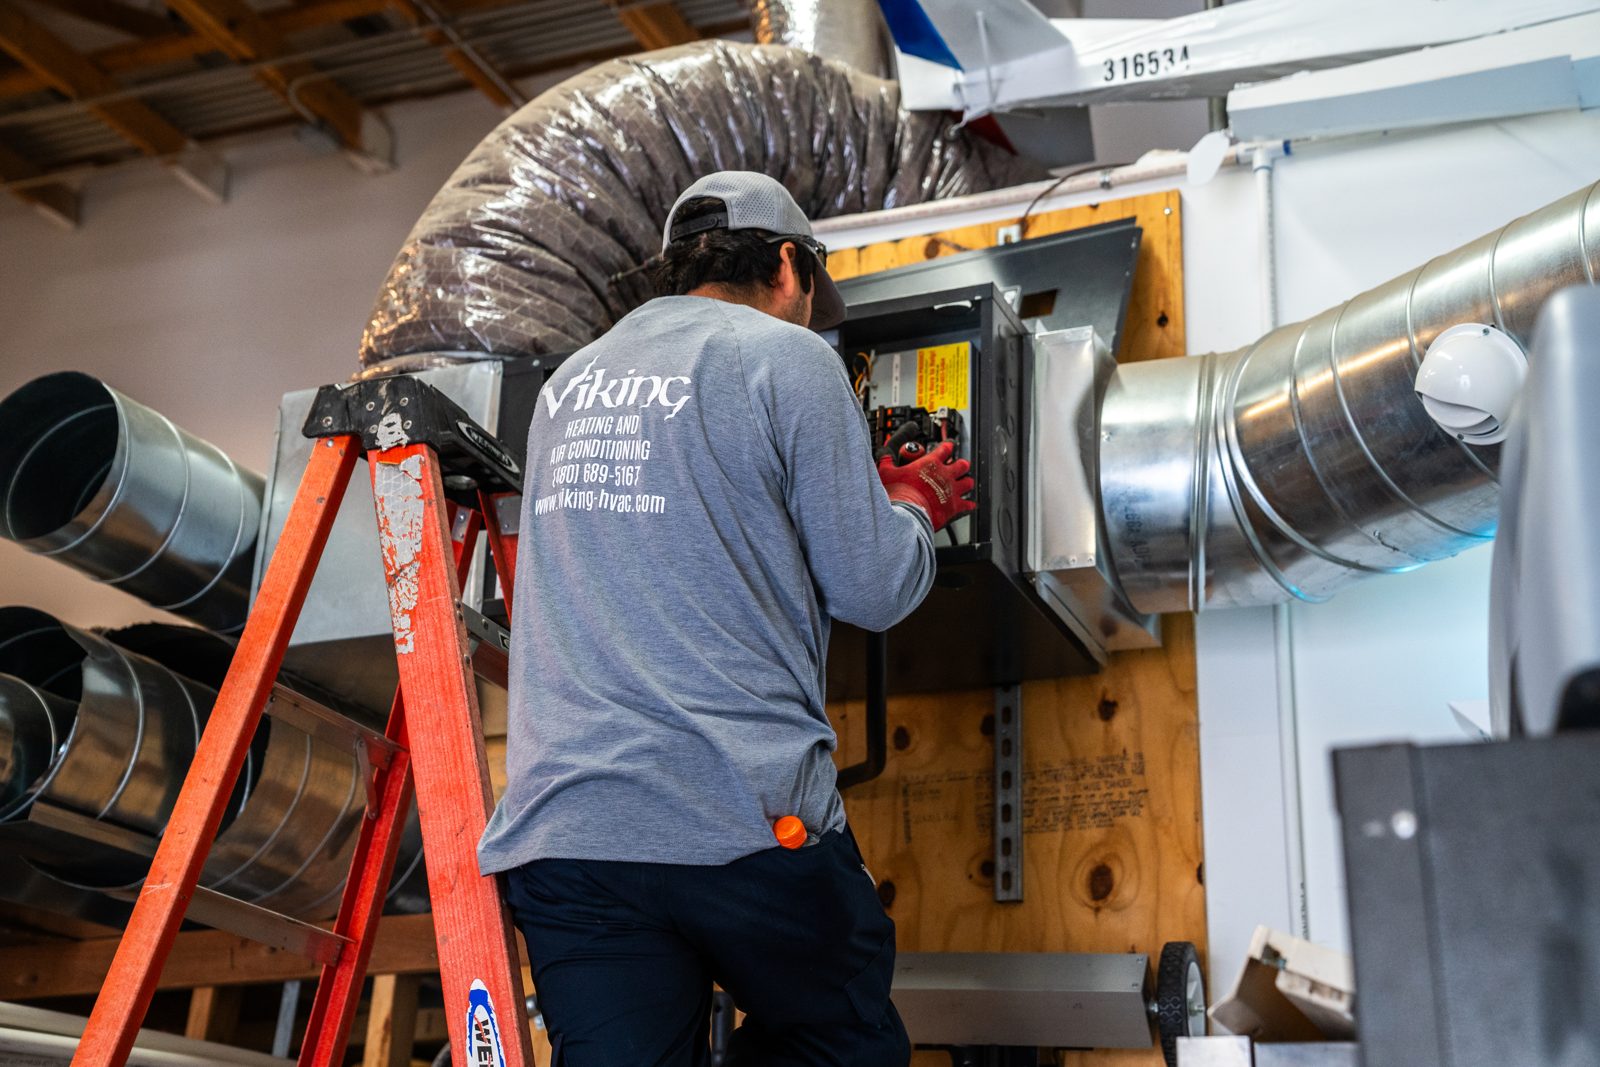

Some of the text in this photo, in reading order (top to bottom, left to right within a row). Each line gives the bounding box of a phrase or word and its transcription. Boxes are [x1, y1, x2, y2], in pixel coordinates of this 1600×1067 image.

[1103, 44, 1190, 82] 316534
[541, 355, 692, 421] Viking
[564, 414, 640, 440] HEATING AND
[549, 439, 651, 467] AIR CONDITIONING
[583, 463, 641, 487] 689-5167
[474, 1019, 495, 1067] WE
